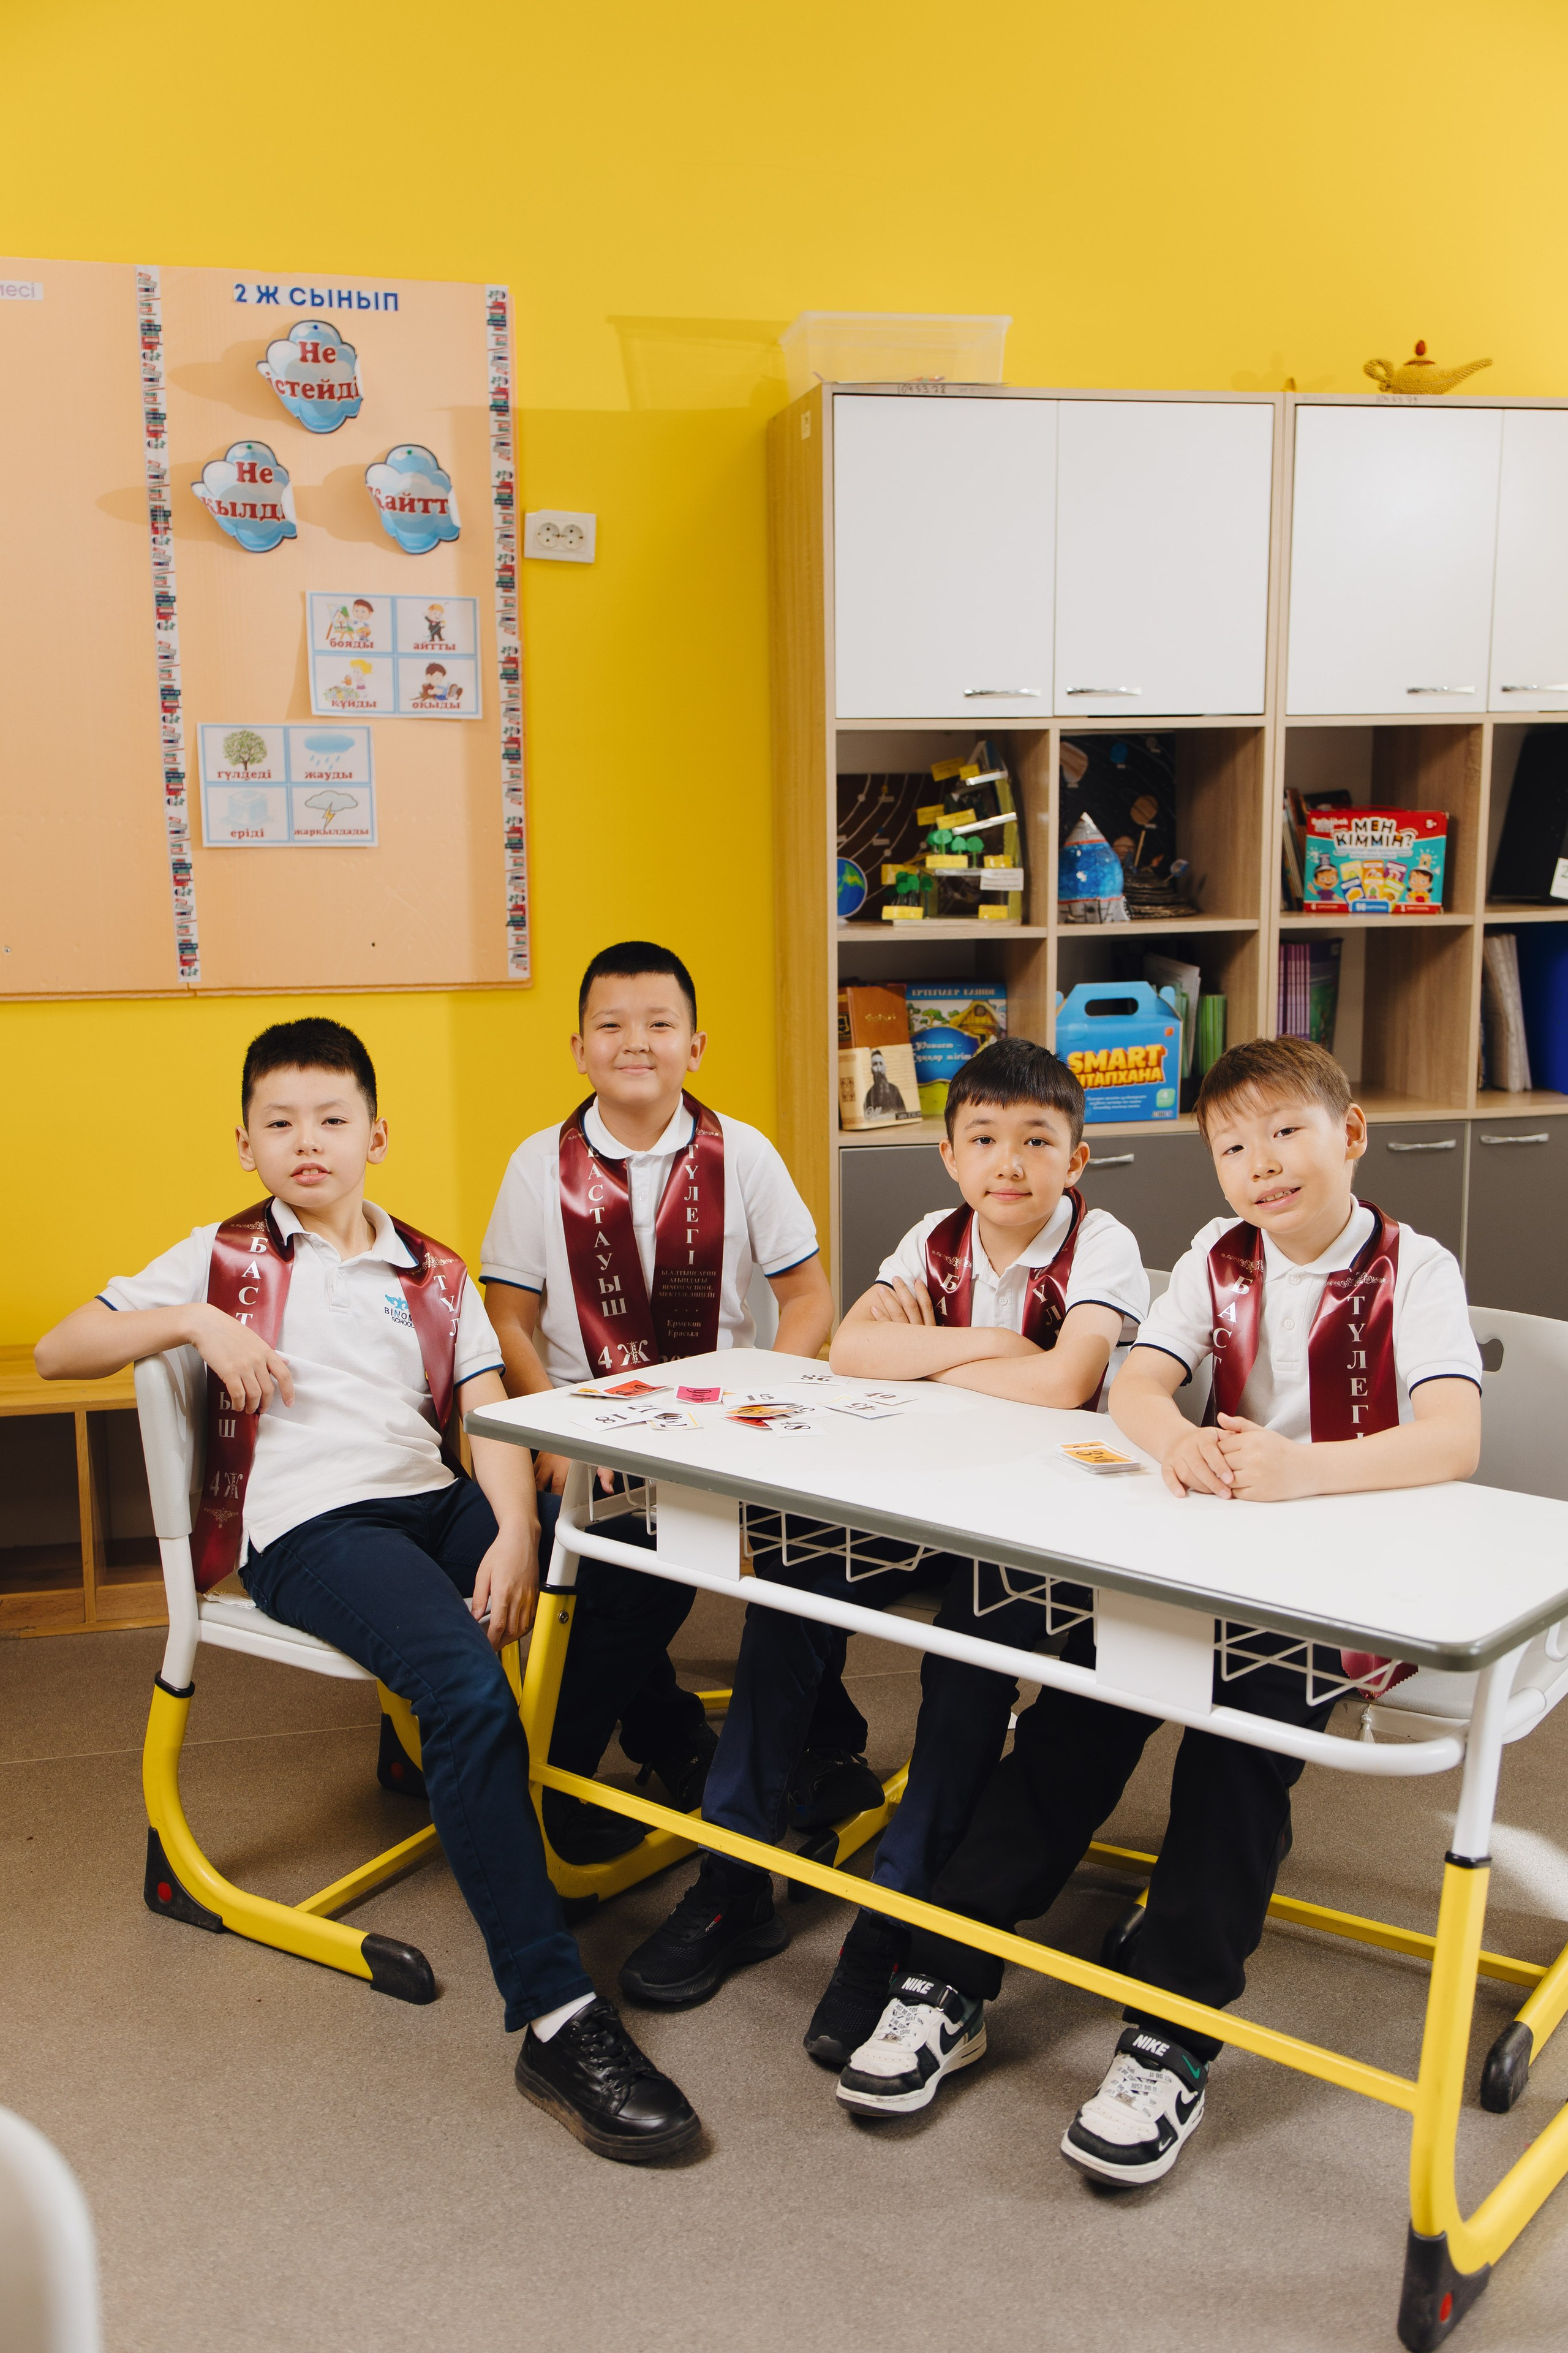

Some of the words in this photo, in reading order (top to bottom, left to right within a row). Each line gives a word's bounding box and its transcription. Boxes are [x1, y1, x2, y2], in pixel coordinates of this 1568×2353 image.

[234, 284, 247, 303] 2
[256, 285, 280, 305] Ж
[288, 287, 399, 312] СЫНЫП
[298, 341, 336, 364] Не
[236, 461, 273, 483] Не
[330, 638, 374, 649] бояды
[413, 641, 456, 651] айтты
[217, 769, 272, 780] гүлдеді
[304, 771, 353, 780] жауды
[230, 828, 265, 839] еріді
[1067, 1044, 1166, 1075] SMART
[391, 1316, 415, 1329] SCHOOL
[901, 1977, 935, 1995] NIKE
[1132, 2034, 1170, 2057] NIKE
